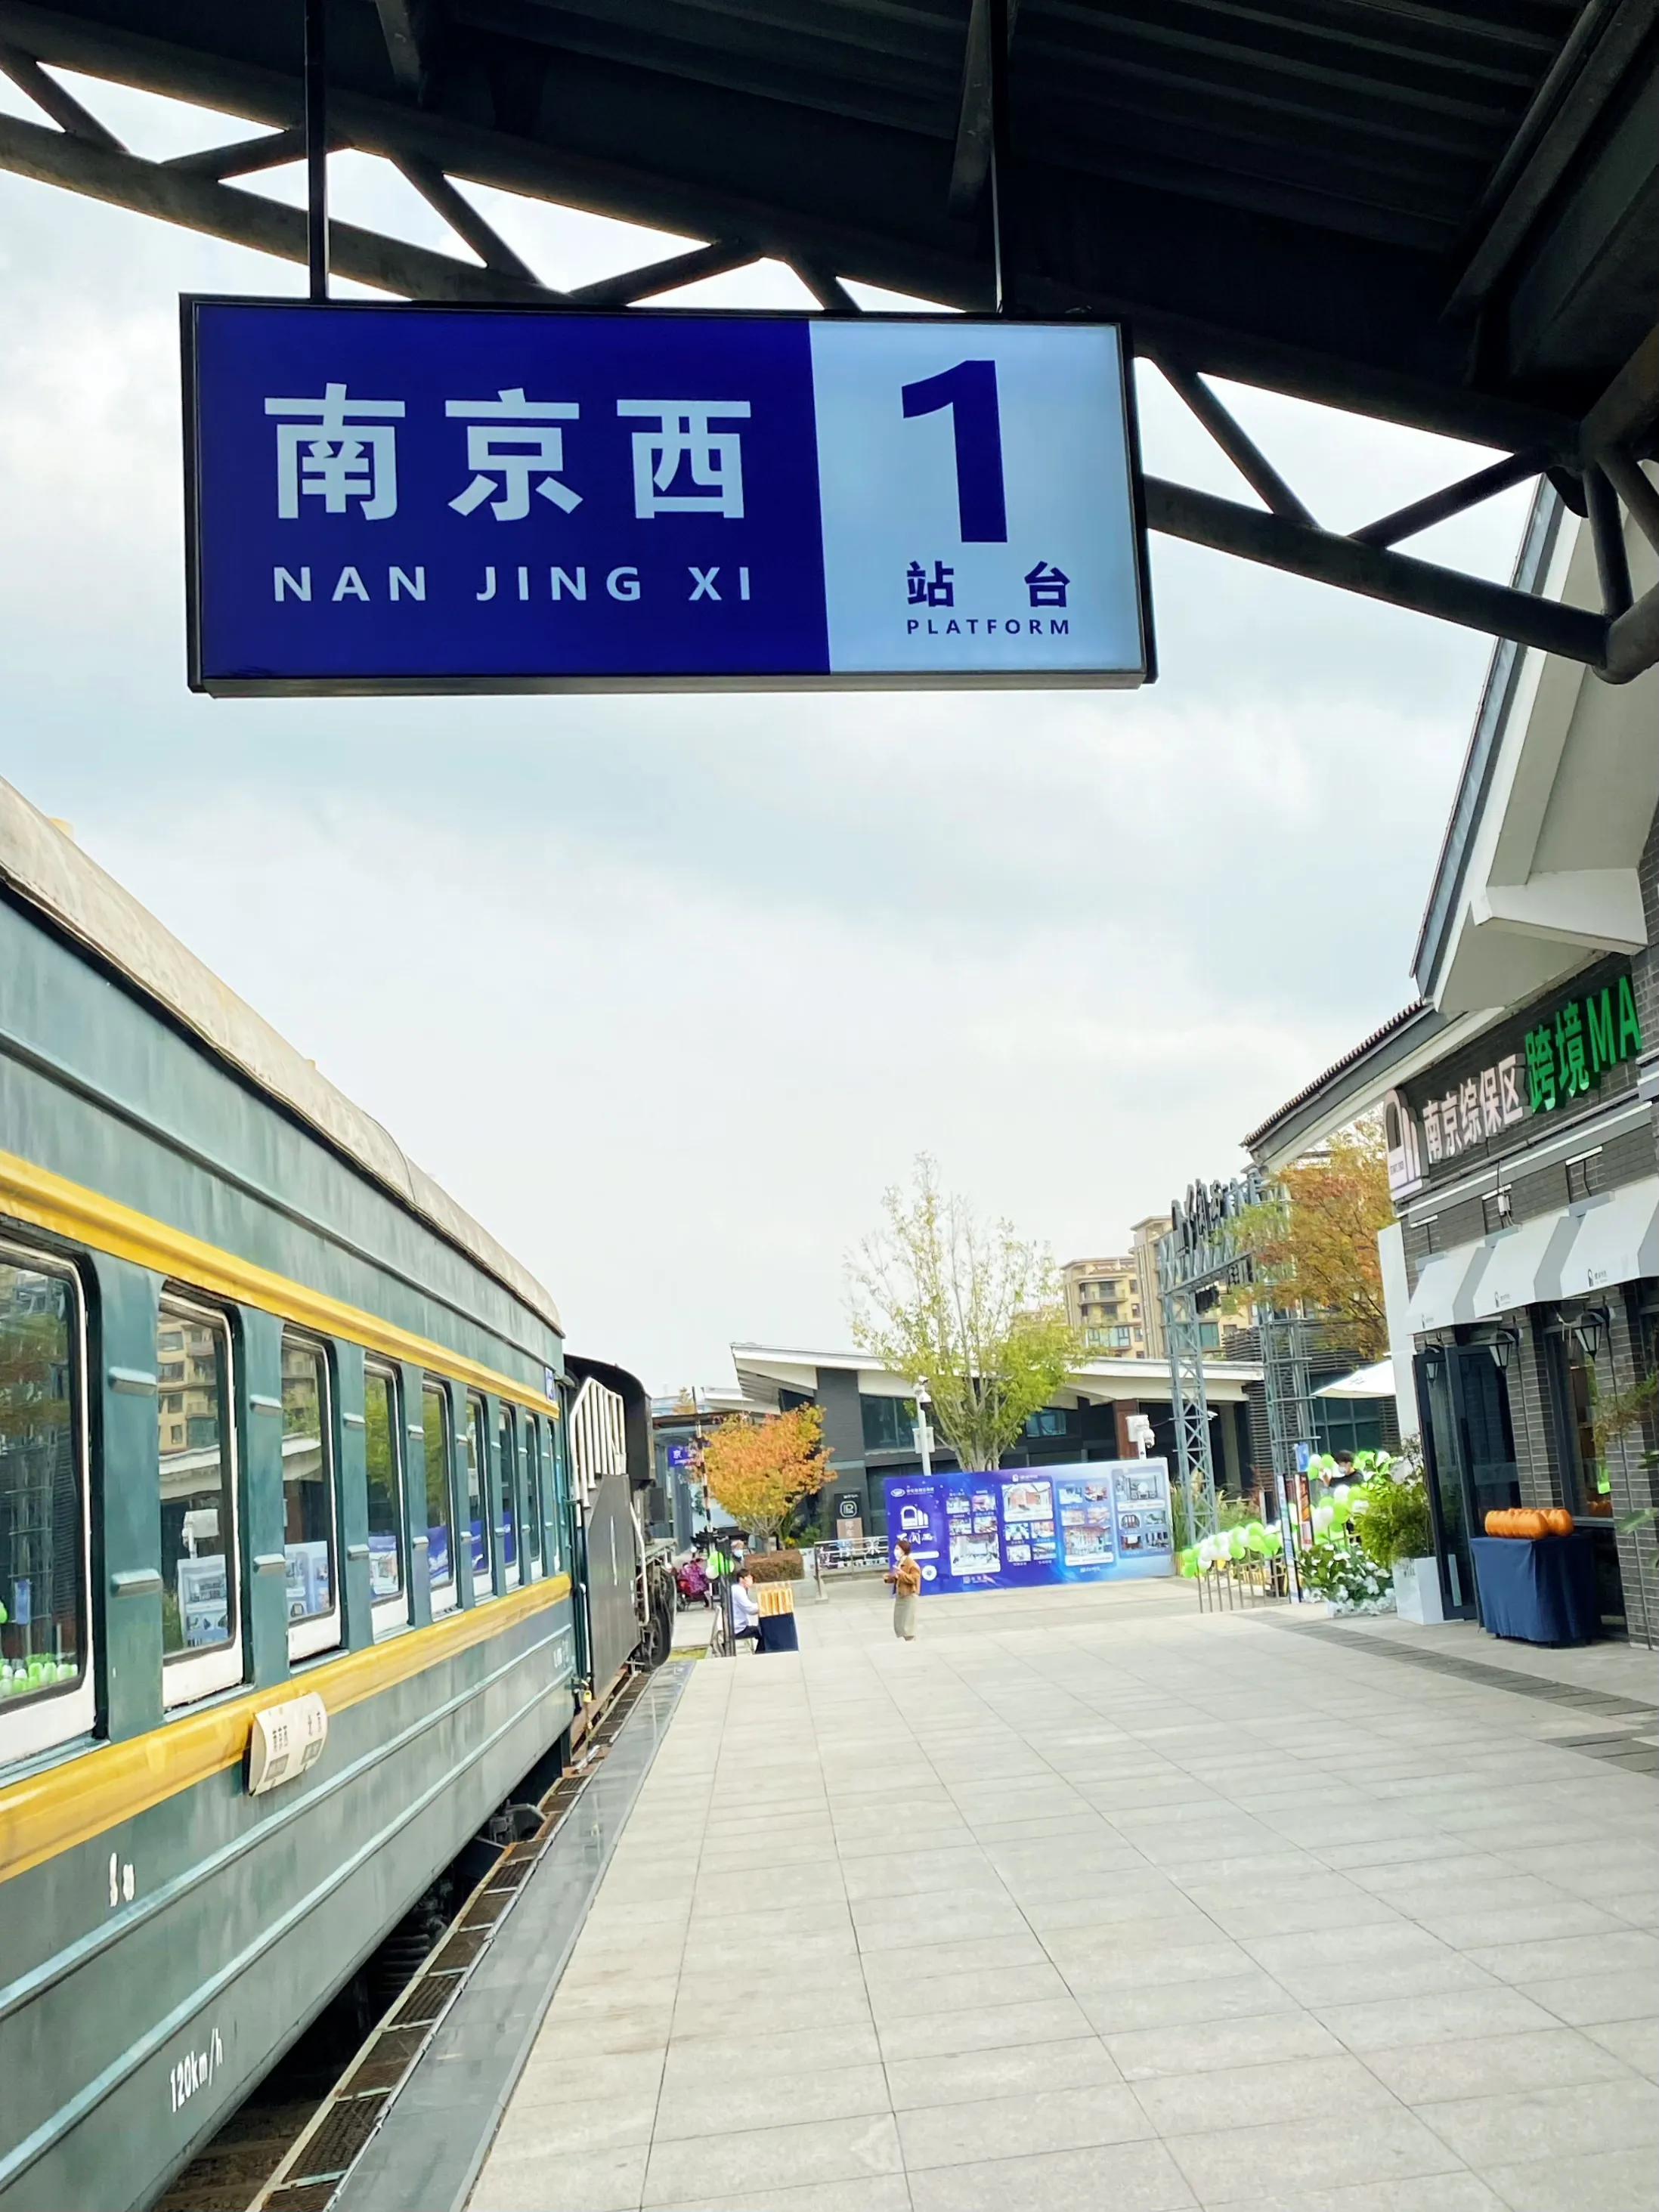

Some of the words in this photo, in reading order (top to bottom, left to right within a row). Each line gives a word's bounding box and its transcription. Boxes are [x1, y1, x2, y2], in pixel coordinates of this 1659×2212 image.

[265, 382, 752, 521] 南京西
[901, 360, 1008, 543] 1
[274, 566, 426, 602] NAN
[476, 566, 641, 601] JING
[688, 567, 751, 601] XI
[906, 618, 1070, 636] PLATFORM
[1422, 1053, 1523, 1164] 南京综保区
[170, 2028, 223, 2113] 120km/h
